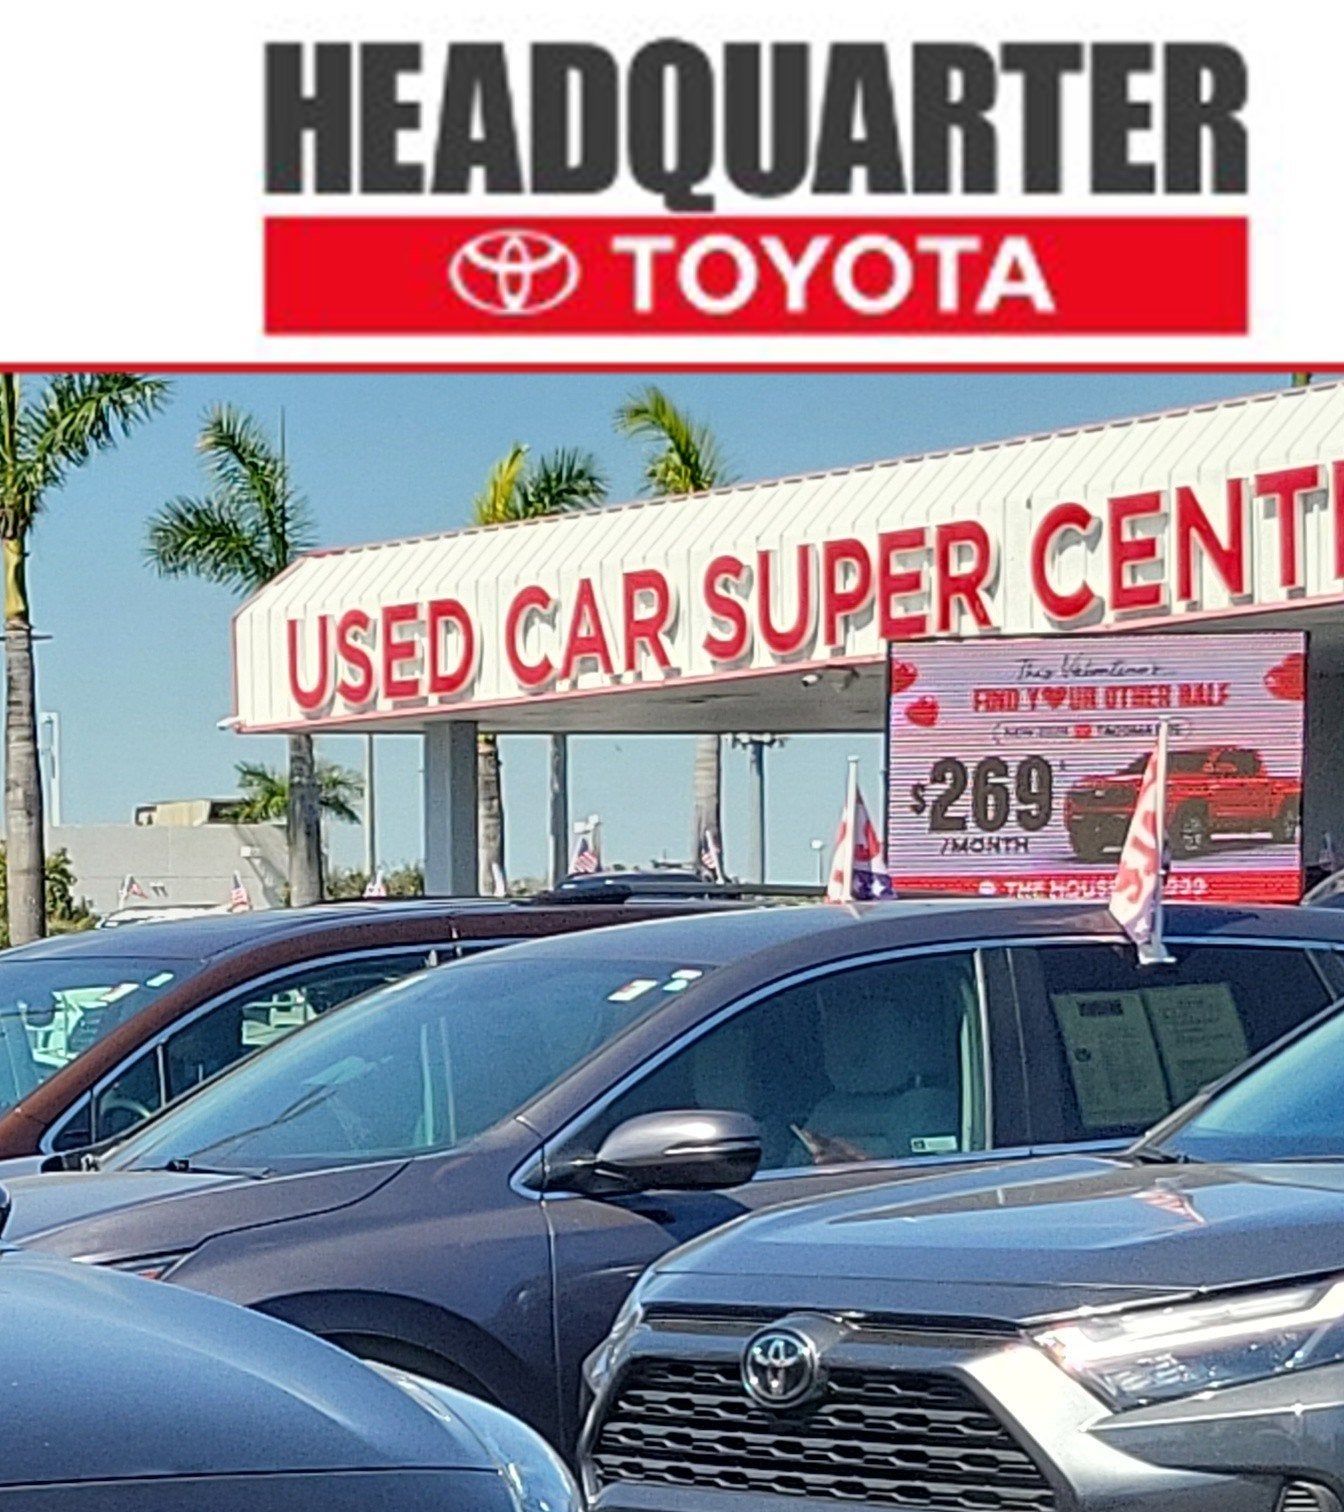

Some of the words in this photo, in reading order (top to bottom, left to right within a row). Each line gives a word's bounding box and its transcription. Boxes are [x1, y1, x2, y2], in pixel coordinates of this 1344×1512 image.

[287, 598, 476, 711] USED
[504, 568, 673, 689] CAR
[702, 520, 993, 662] SUPER
[910, 755, 1054, 832] $269
